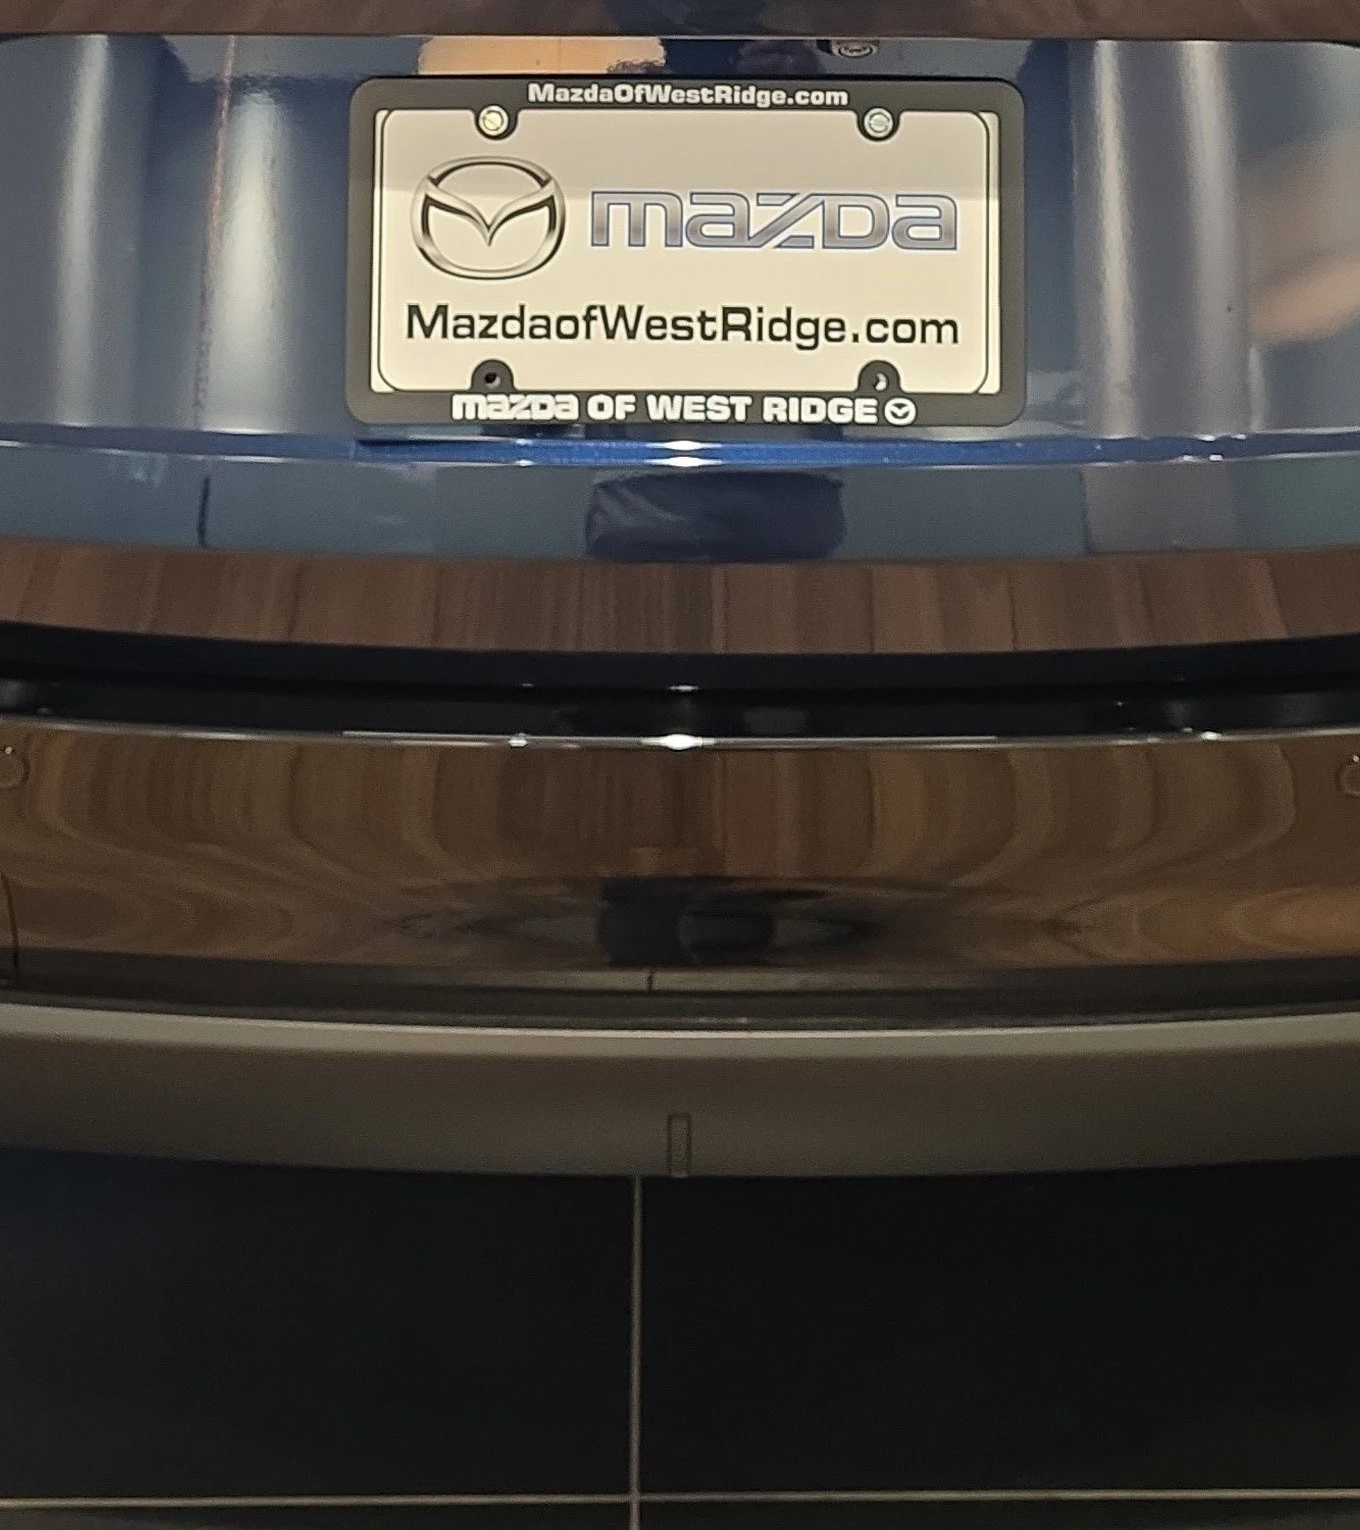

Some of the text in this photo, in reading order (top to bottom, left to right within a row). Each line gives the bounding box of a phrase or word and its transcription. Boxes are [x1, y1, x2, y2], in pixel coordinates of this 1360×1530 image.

[527, 82, 849, 108] MazdaOfWestRidge.com
[405, 304, 960, 350] MazdaofWestRidge.com
[587, 394, 636, 419] OF
[646, 396, 753, 423] WEST
[762, 397, 878, 425] RIDGE
